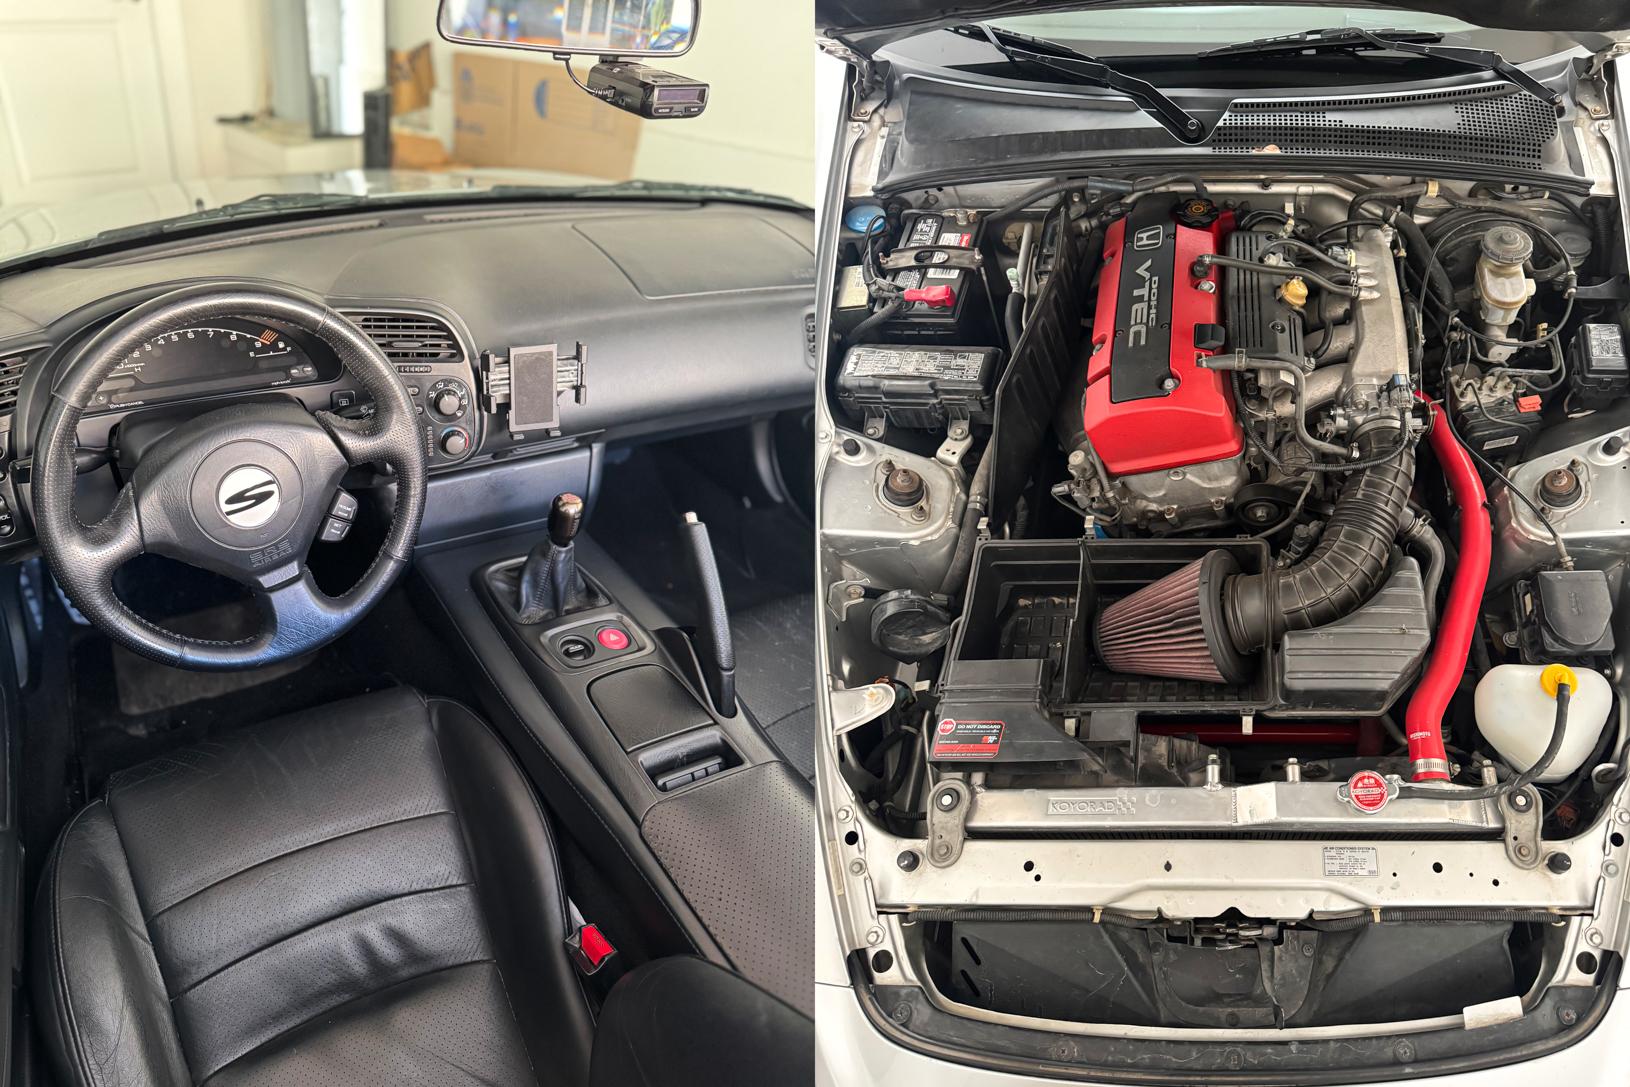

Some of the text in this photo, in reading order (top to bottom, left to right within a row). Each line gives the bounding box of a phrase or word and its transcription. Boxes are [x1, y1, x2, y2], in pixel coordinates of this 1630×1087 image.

[1128, 258, 1152, 348] VTEC
[1150, 276, 1159, 328] DOHC
[132, 350, 141, 358] 2
[144, 343, 152, 352] 3
[170, 334, 179, 342] 5
[186, 331, 195, 339] 6
[229, 333, 238, 341] 8
[1050, 800, 1116, 813] KOYORAD
